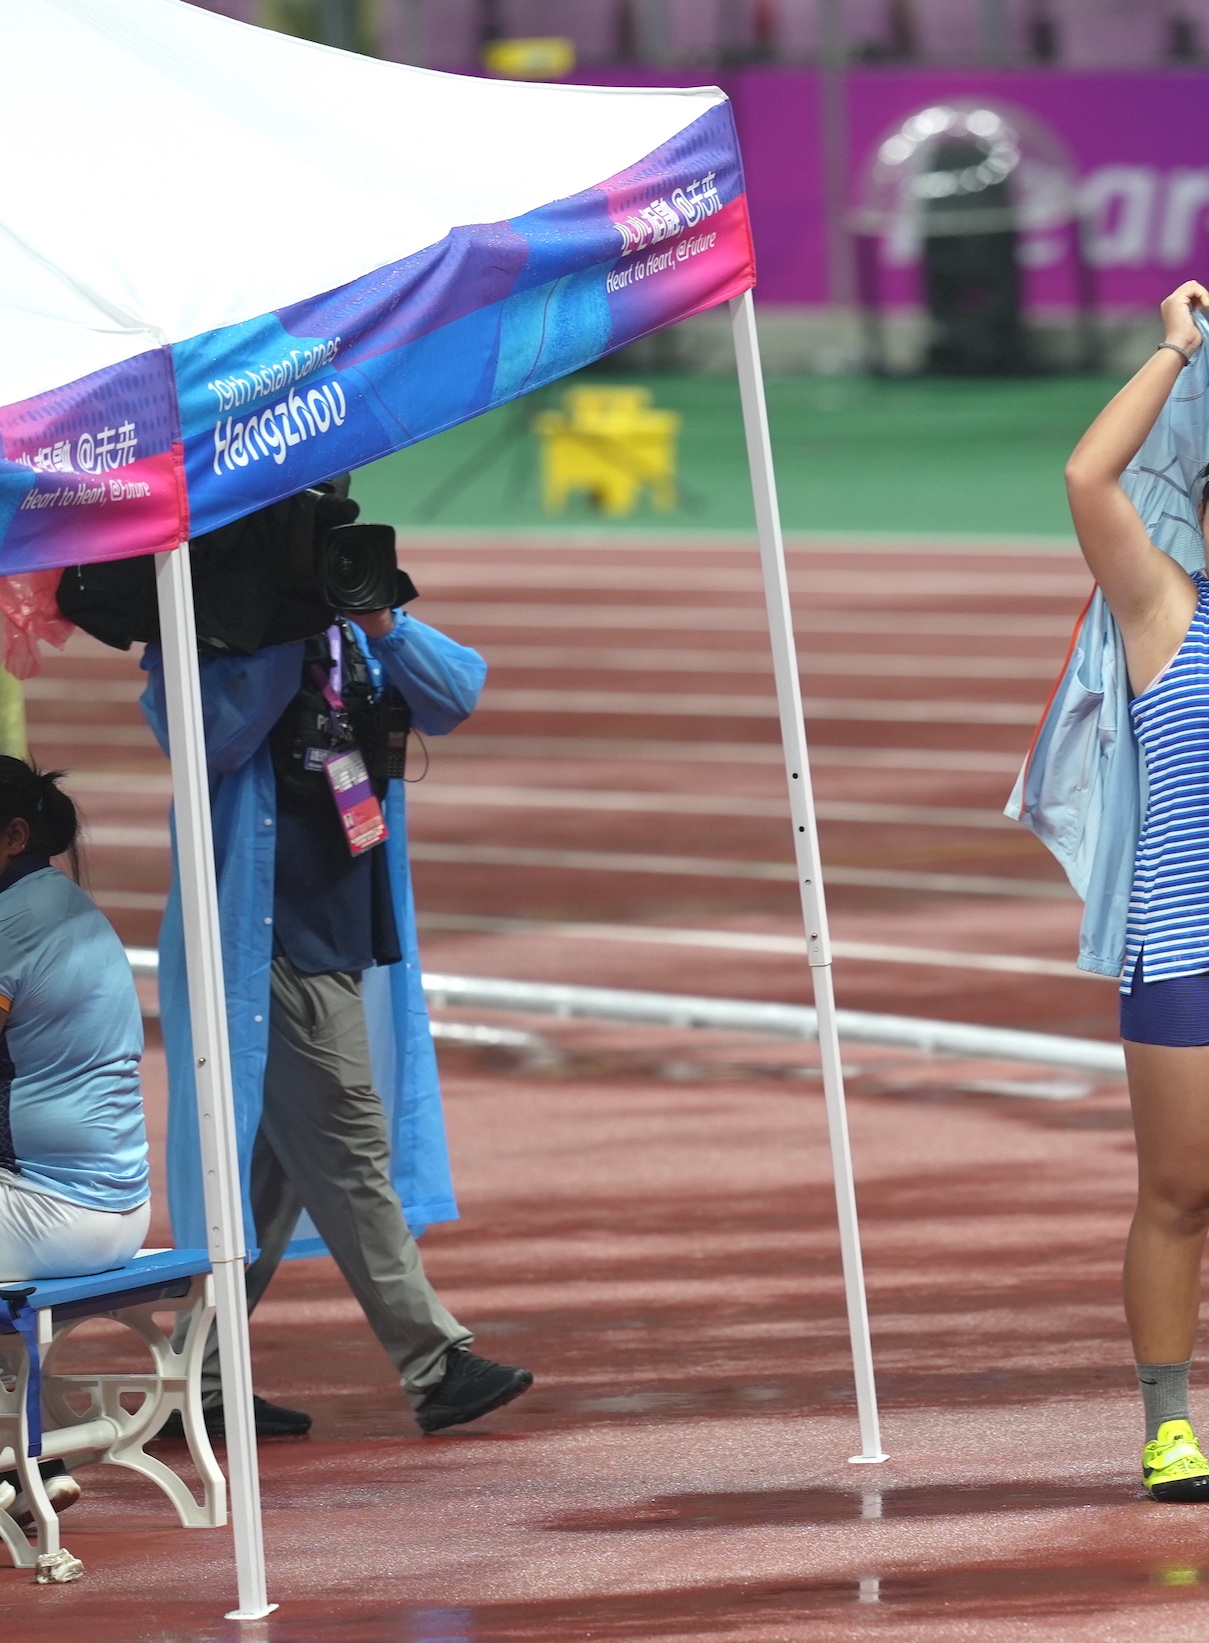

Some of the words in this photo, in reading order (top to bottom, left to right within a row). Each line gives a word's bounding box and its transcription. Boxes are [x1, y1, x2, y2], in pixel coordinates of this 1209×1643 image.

[606, 264, 633, 293] Heart
[634, 261, 645, 281] to
[646, 247, 676, 276] Heart,
[676, 232, 717, 262] @Future
[208, 376, 251, 412] 19th
[245, 360, 293, 400] Asian
[290, 337, 341, 380] Games
[213, 381, 346, 475] Hangzhou
[21, 487, 60, 510] Heart
[58, 486, 74, 507] to
[109, 479, 151, 502] @Future
